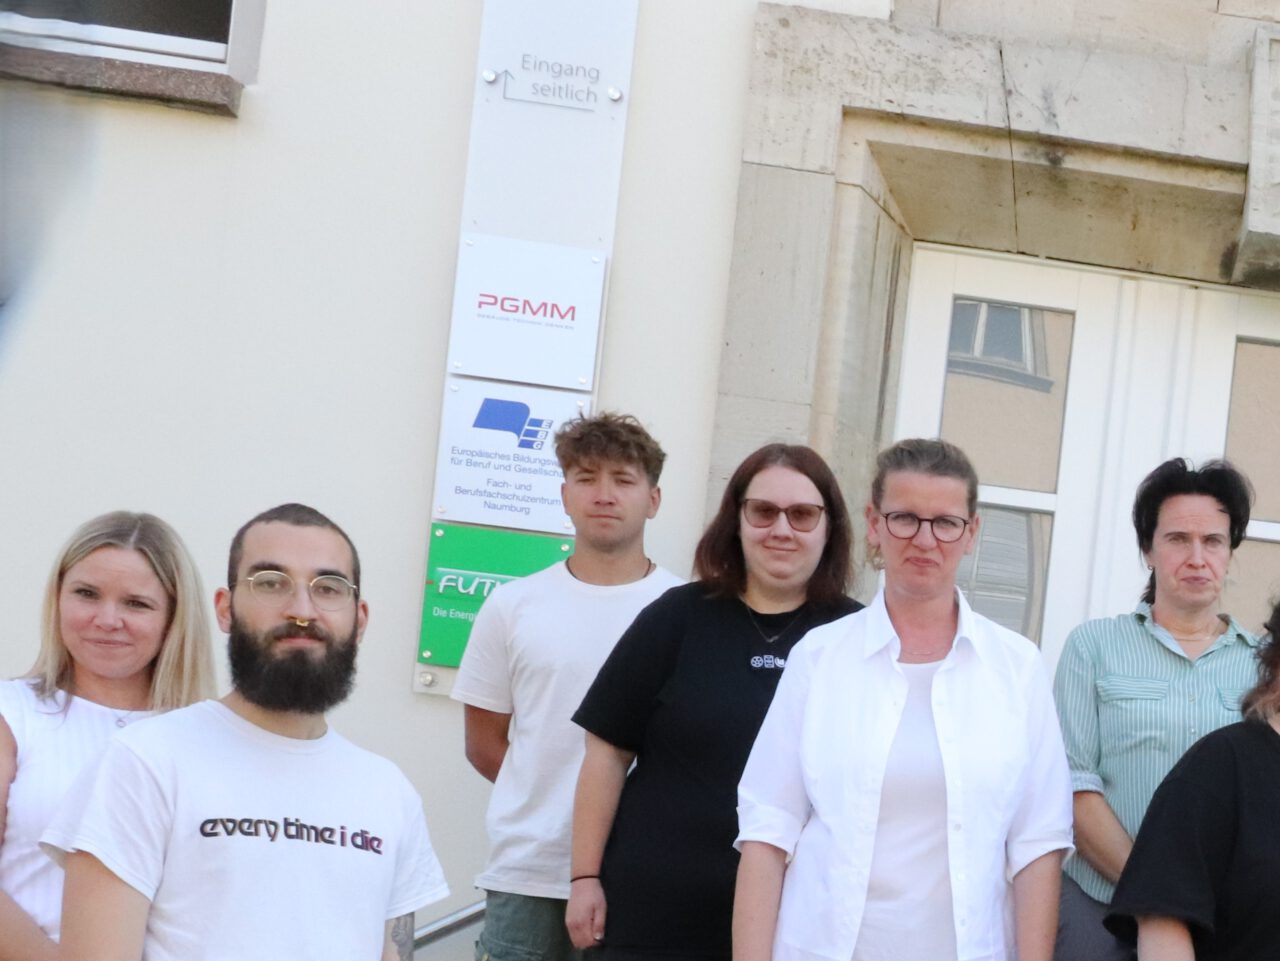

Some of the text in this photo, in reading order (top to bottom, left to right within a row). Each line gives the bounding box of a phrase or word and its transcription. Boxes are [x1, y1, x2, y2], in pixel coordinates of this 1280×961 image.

[521, 53, 601, 84] Eingang
[531, 80, 599, 103] seitlich
[477, 293, 577, 322] PGMM
[451, 445, 511, 461] Europäisches
[450, 456, 464, 466] für
[465, 458, 492, 469] Beruf
[493, 463, 512, 472] und
[454, 485, 561, 506] Berufsfachschulzentrum
[486, 478, 532, 492] Fach- und
[483, 500, 531, 515] Naumburg
[438, 574, 500, 597] FUT
[432, 606, 476, 622] Die Energ
[199, 816, 384, 856] every time i die
